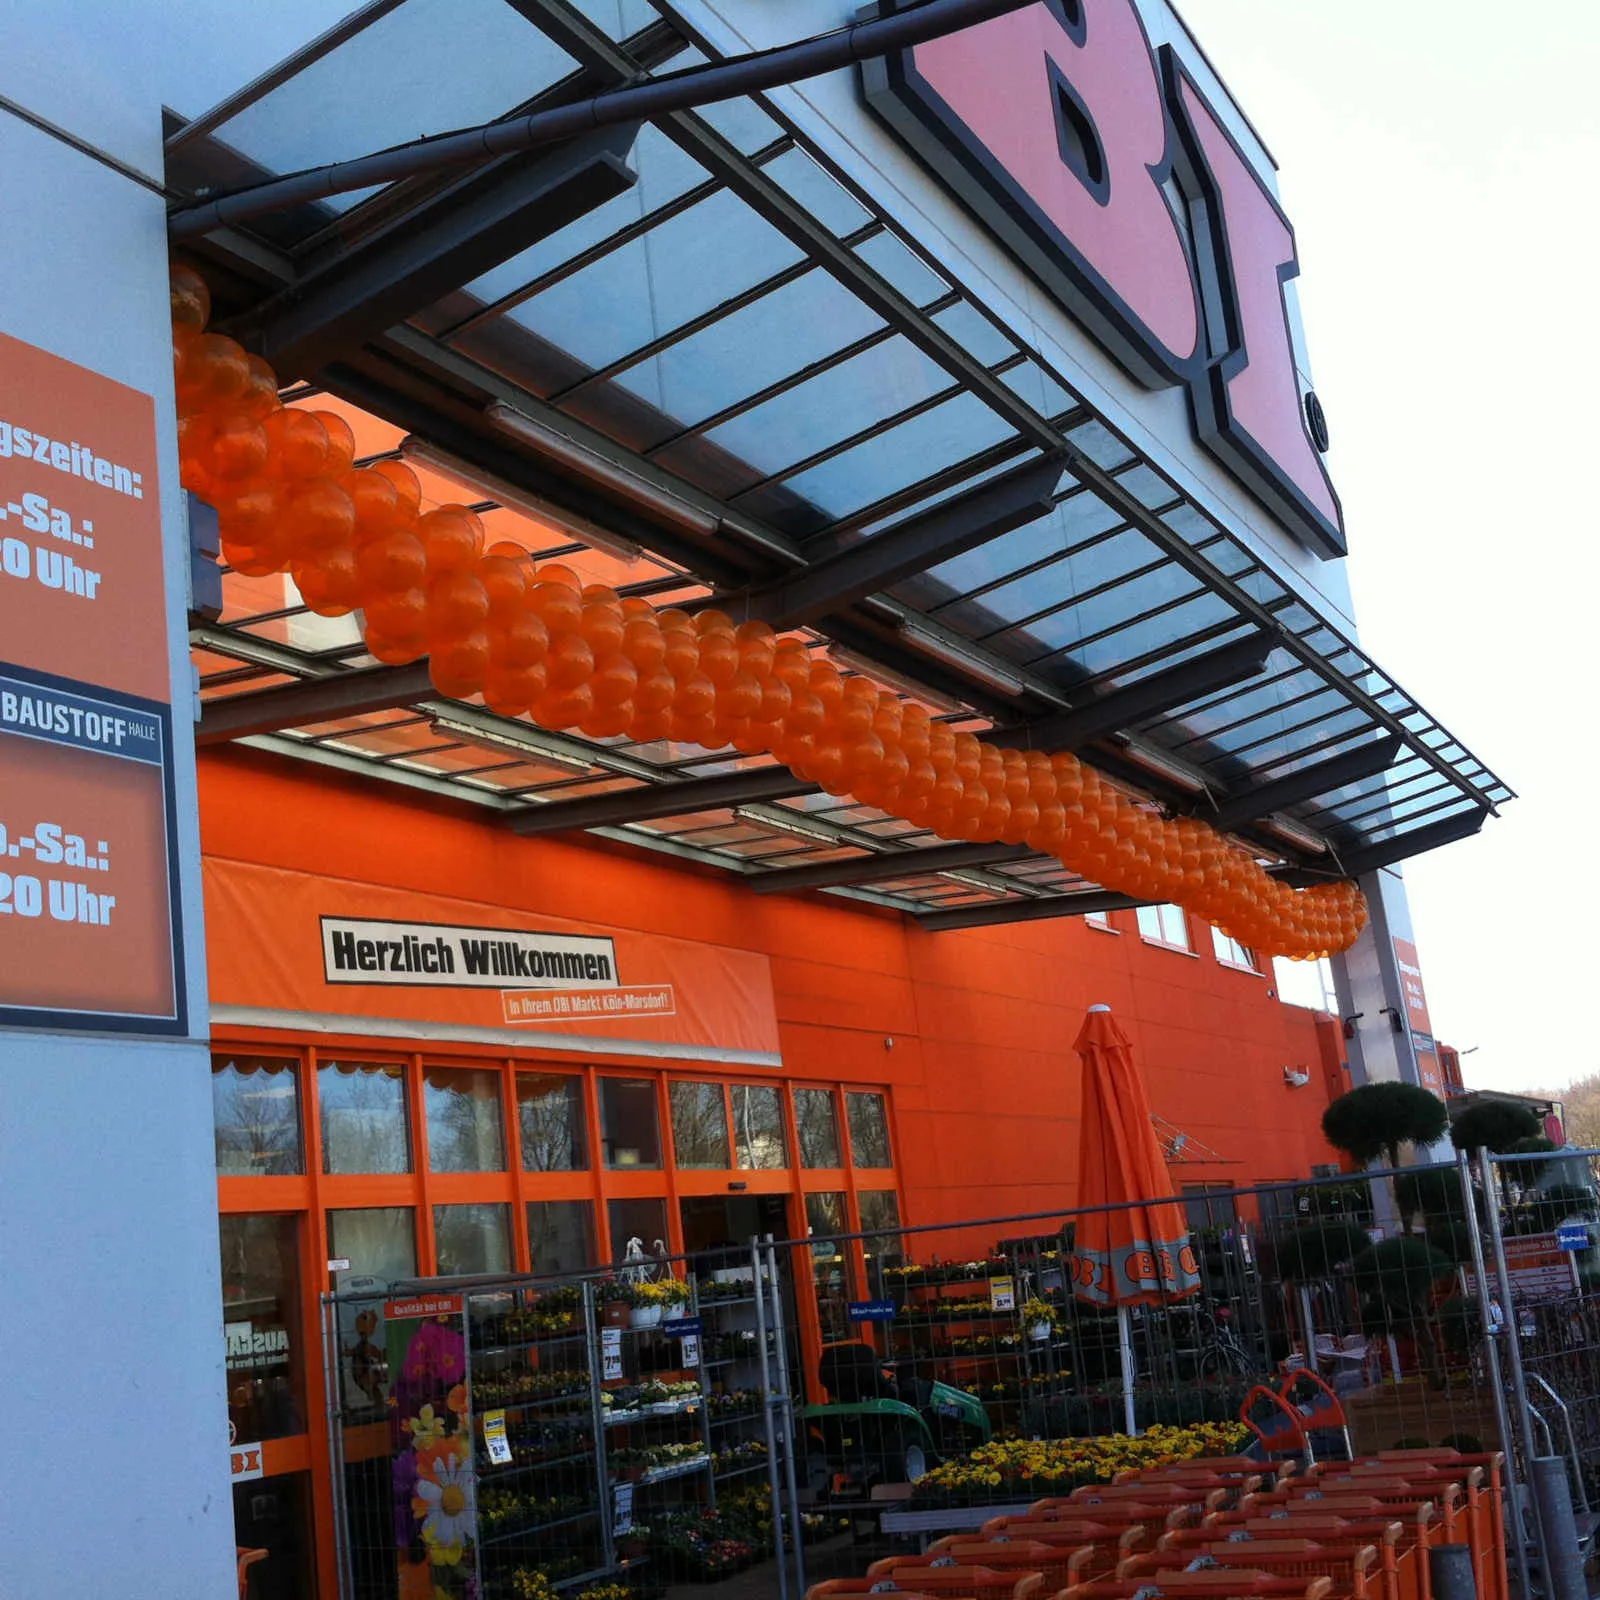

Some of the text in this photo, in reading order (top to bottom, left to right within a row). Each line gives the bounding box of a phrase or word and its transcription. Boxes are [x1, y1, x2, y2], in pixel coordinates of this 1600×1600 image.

[36, 547, 102, 600] Uhr
[1, 691, 156, 746] BAUSTOFF HALLE
[48, 880, 116, 926] Uhr
[331, 930, 611, 980] Herzlich Willkommen
[572, 995, 601, 1012] Markt
